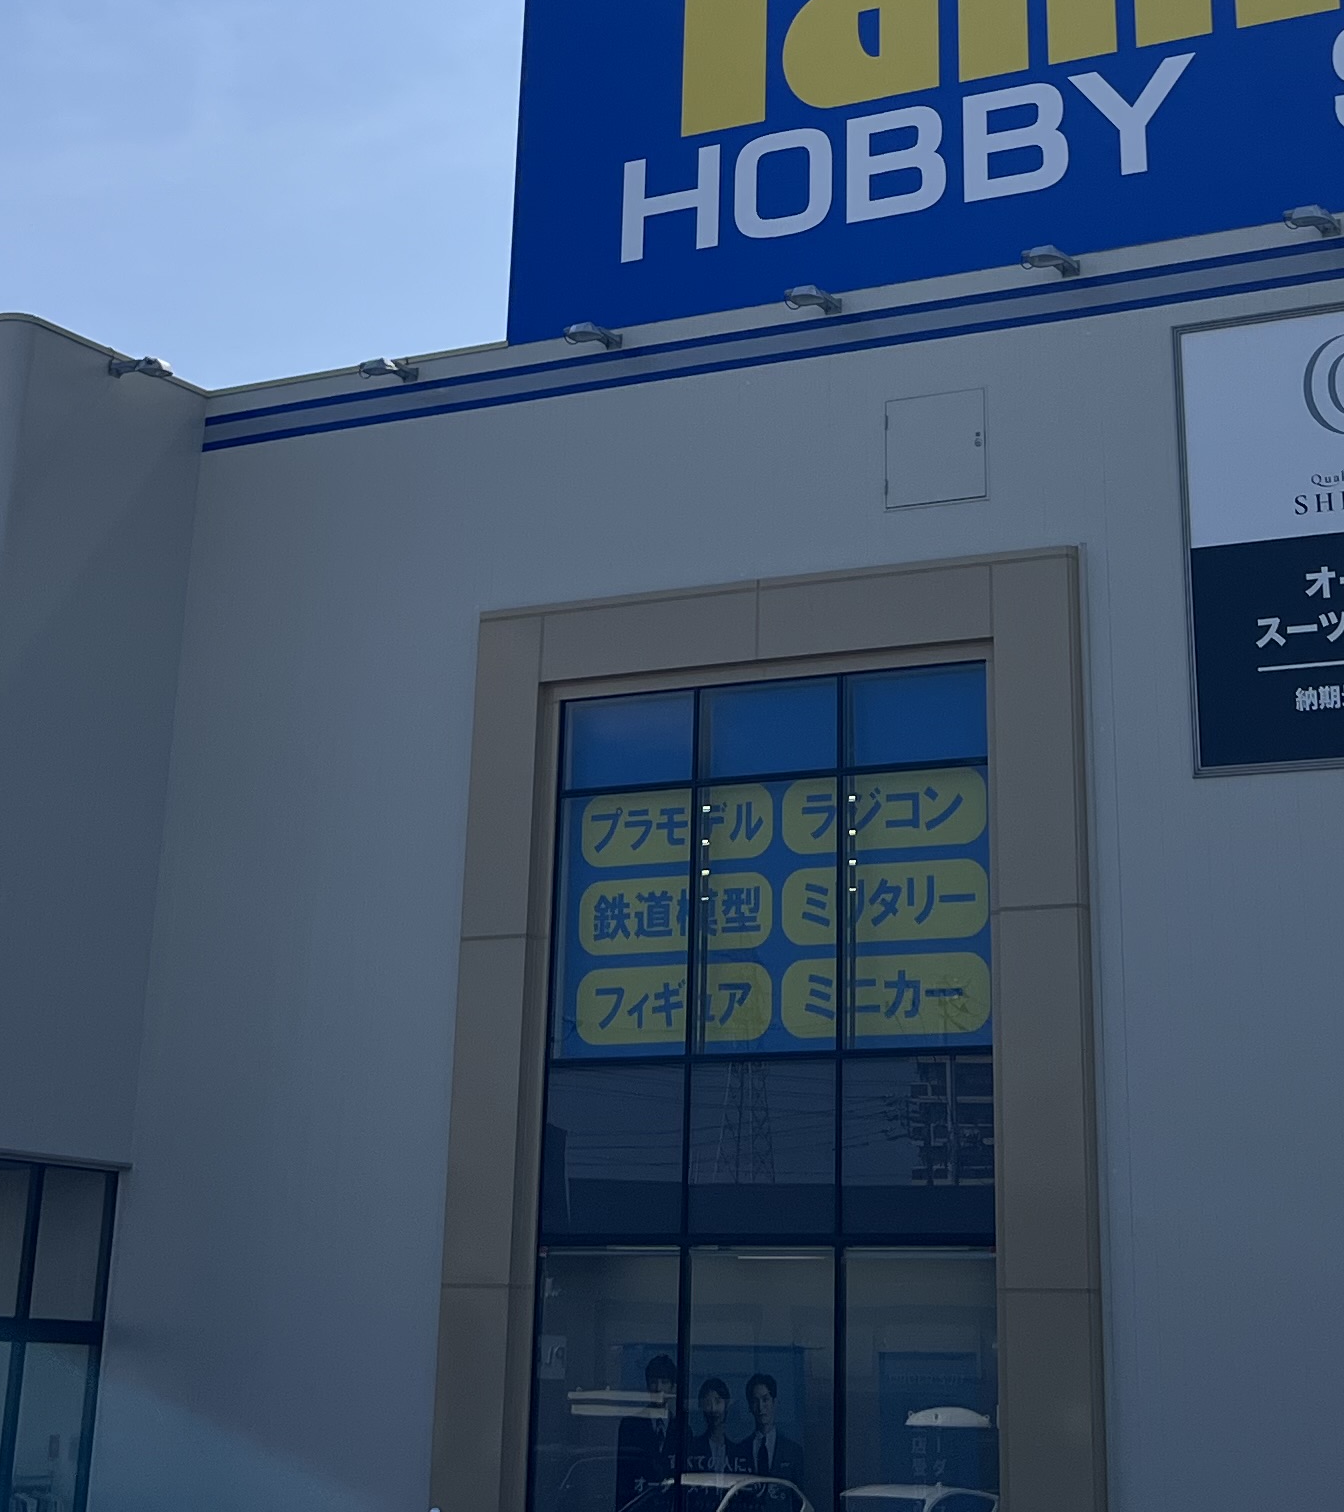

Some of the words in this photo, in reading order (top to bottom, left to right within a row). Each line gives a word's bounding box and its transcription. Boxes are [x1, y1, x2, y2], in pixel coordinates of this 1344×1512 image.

[620, 53, 1196, 264] HOBBY
[591, 801, 764, 853] プラモデル
[801, 787, 964, 839] ラジコン
[592, 886, 761, 942] 鉄道模型
[804, 969, 964, 1021] ミニカー
